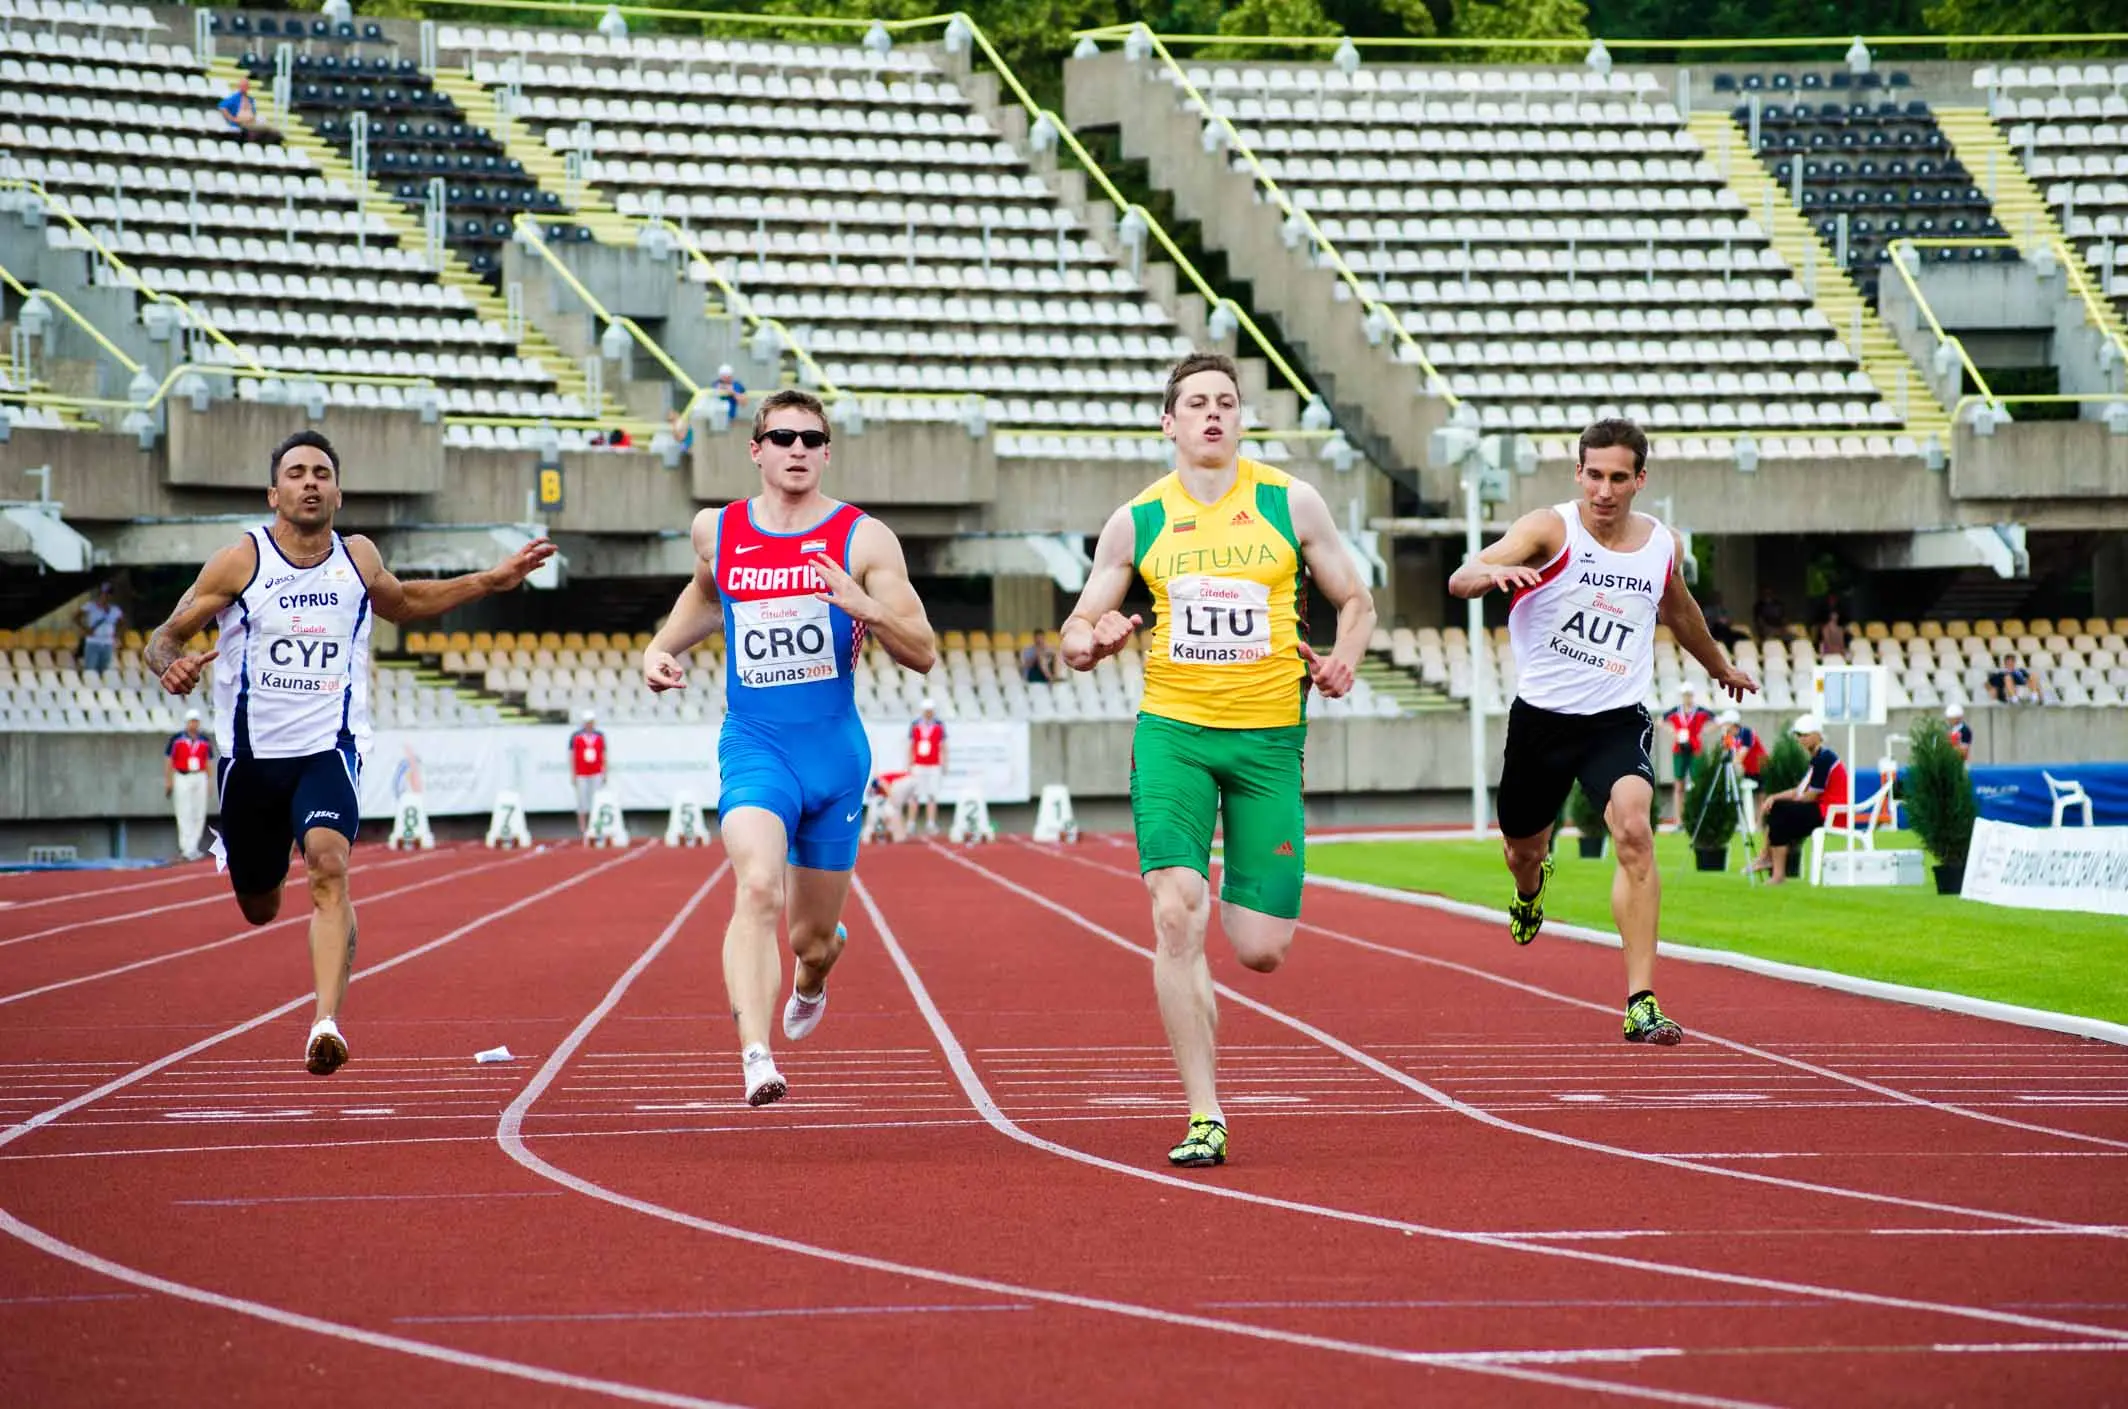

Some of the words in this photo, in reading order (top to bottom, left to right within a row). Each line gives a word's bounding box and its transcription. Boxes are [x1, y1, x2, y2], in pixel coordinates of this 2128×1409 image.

[1155, 543, 1278, 580] LIETUVA
[273, 574, 295, 586] asics
[1579, 572, 1652, 594] AUSTRIA
[279, 592, 338, 609] CYPRUS
[1185, 605, 1254, 637] LTU
[1560, 611, 1634, 651] AUT
[270, 638, 339, 668] CYP
[744, 624, 824, 660] CRO
[404, 806, 419, 828] 8
[501, 806, 516, 827] 7
[599, 804, 614, 826] 6
[680, 803, 694, 825] 5
[964, 800, 979, 822] 2
[1052, 799, 1062, 821] 1
